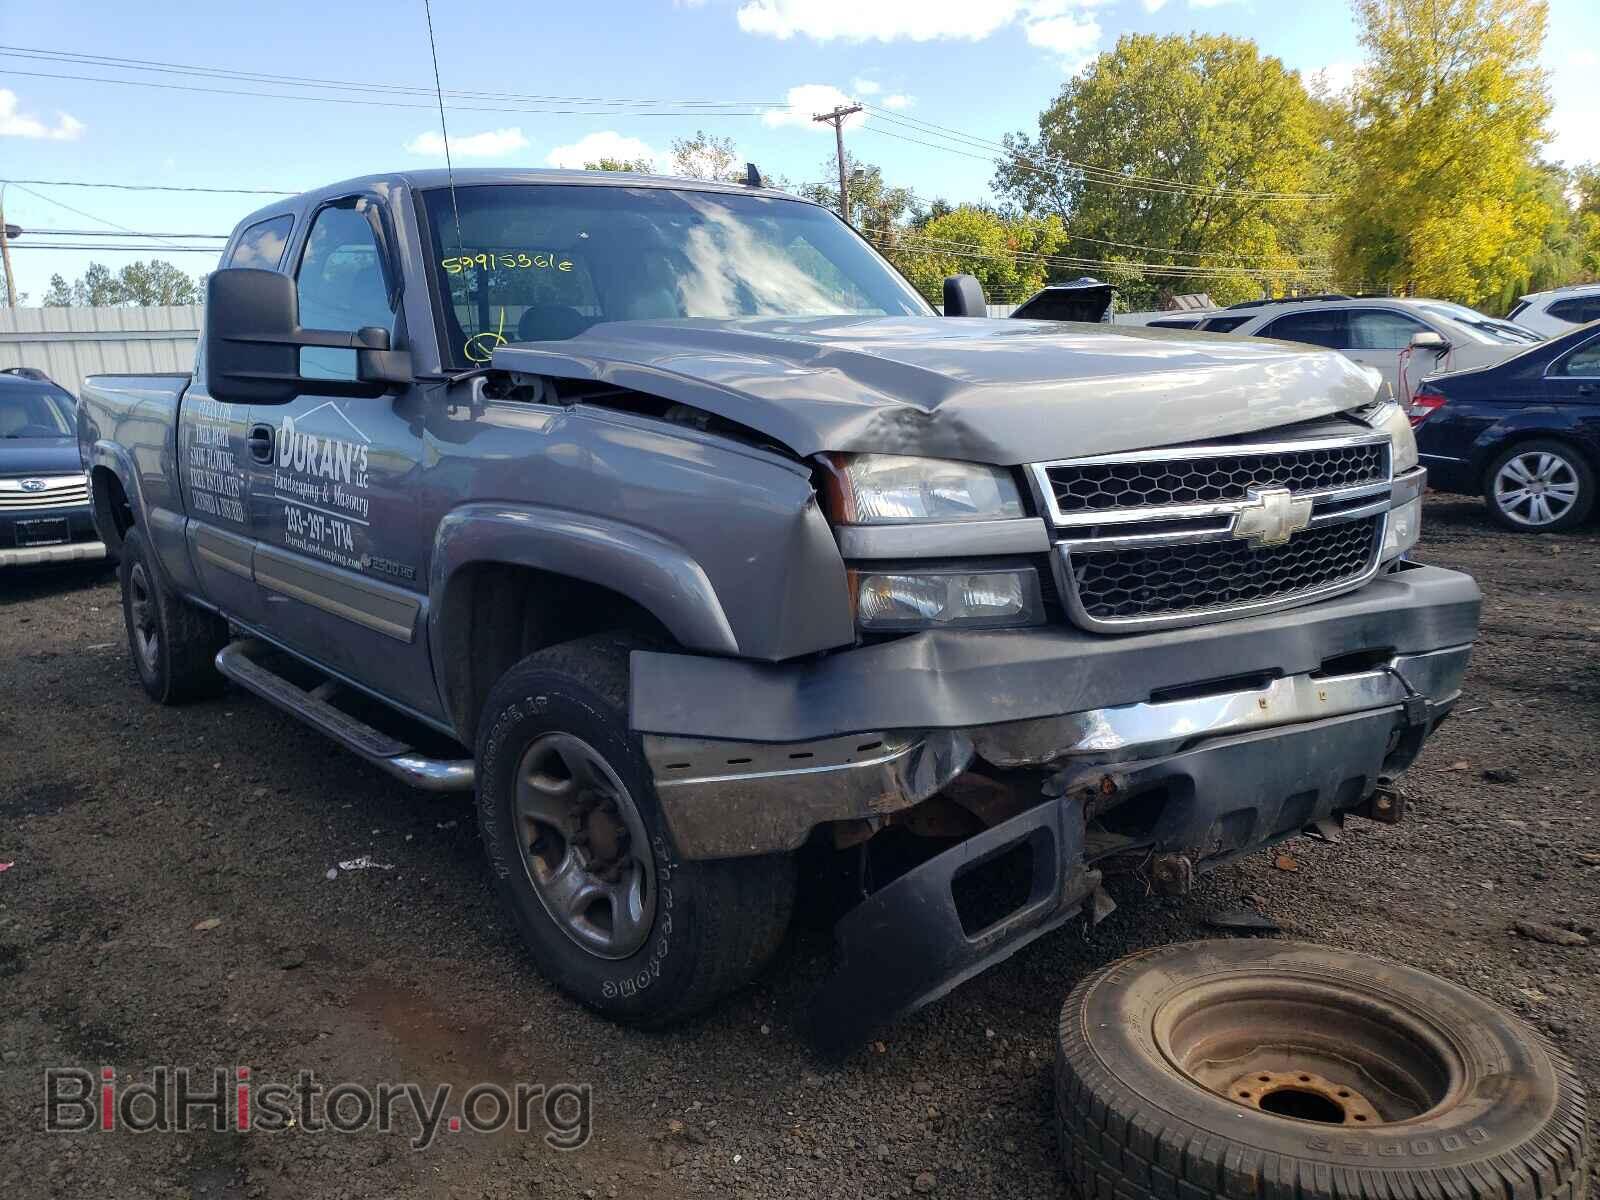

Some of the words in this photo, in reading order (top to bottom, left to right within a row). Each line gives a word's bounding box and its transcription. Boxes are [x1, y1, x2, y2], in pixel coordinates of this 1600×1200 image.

[279, 415, 369, 484] DURAN'S
[275, 469, 320, 504] Landscaping
[322, 482, 329, 504] &
[333, 484, 369, 518] Masonry
[356, 471, 369, 489] LLC
[285, 505, 354, 552] 203-297-1714
